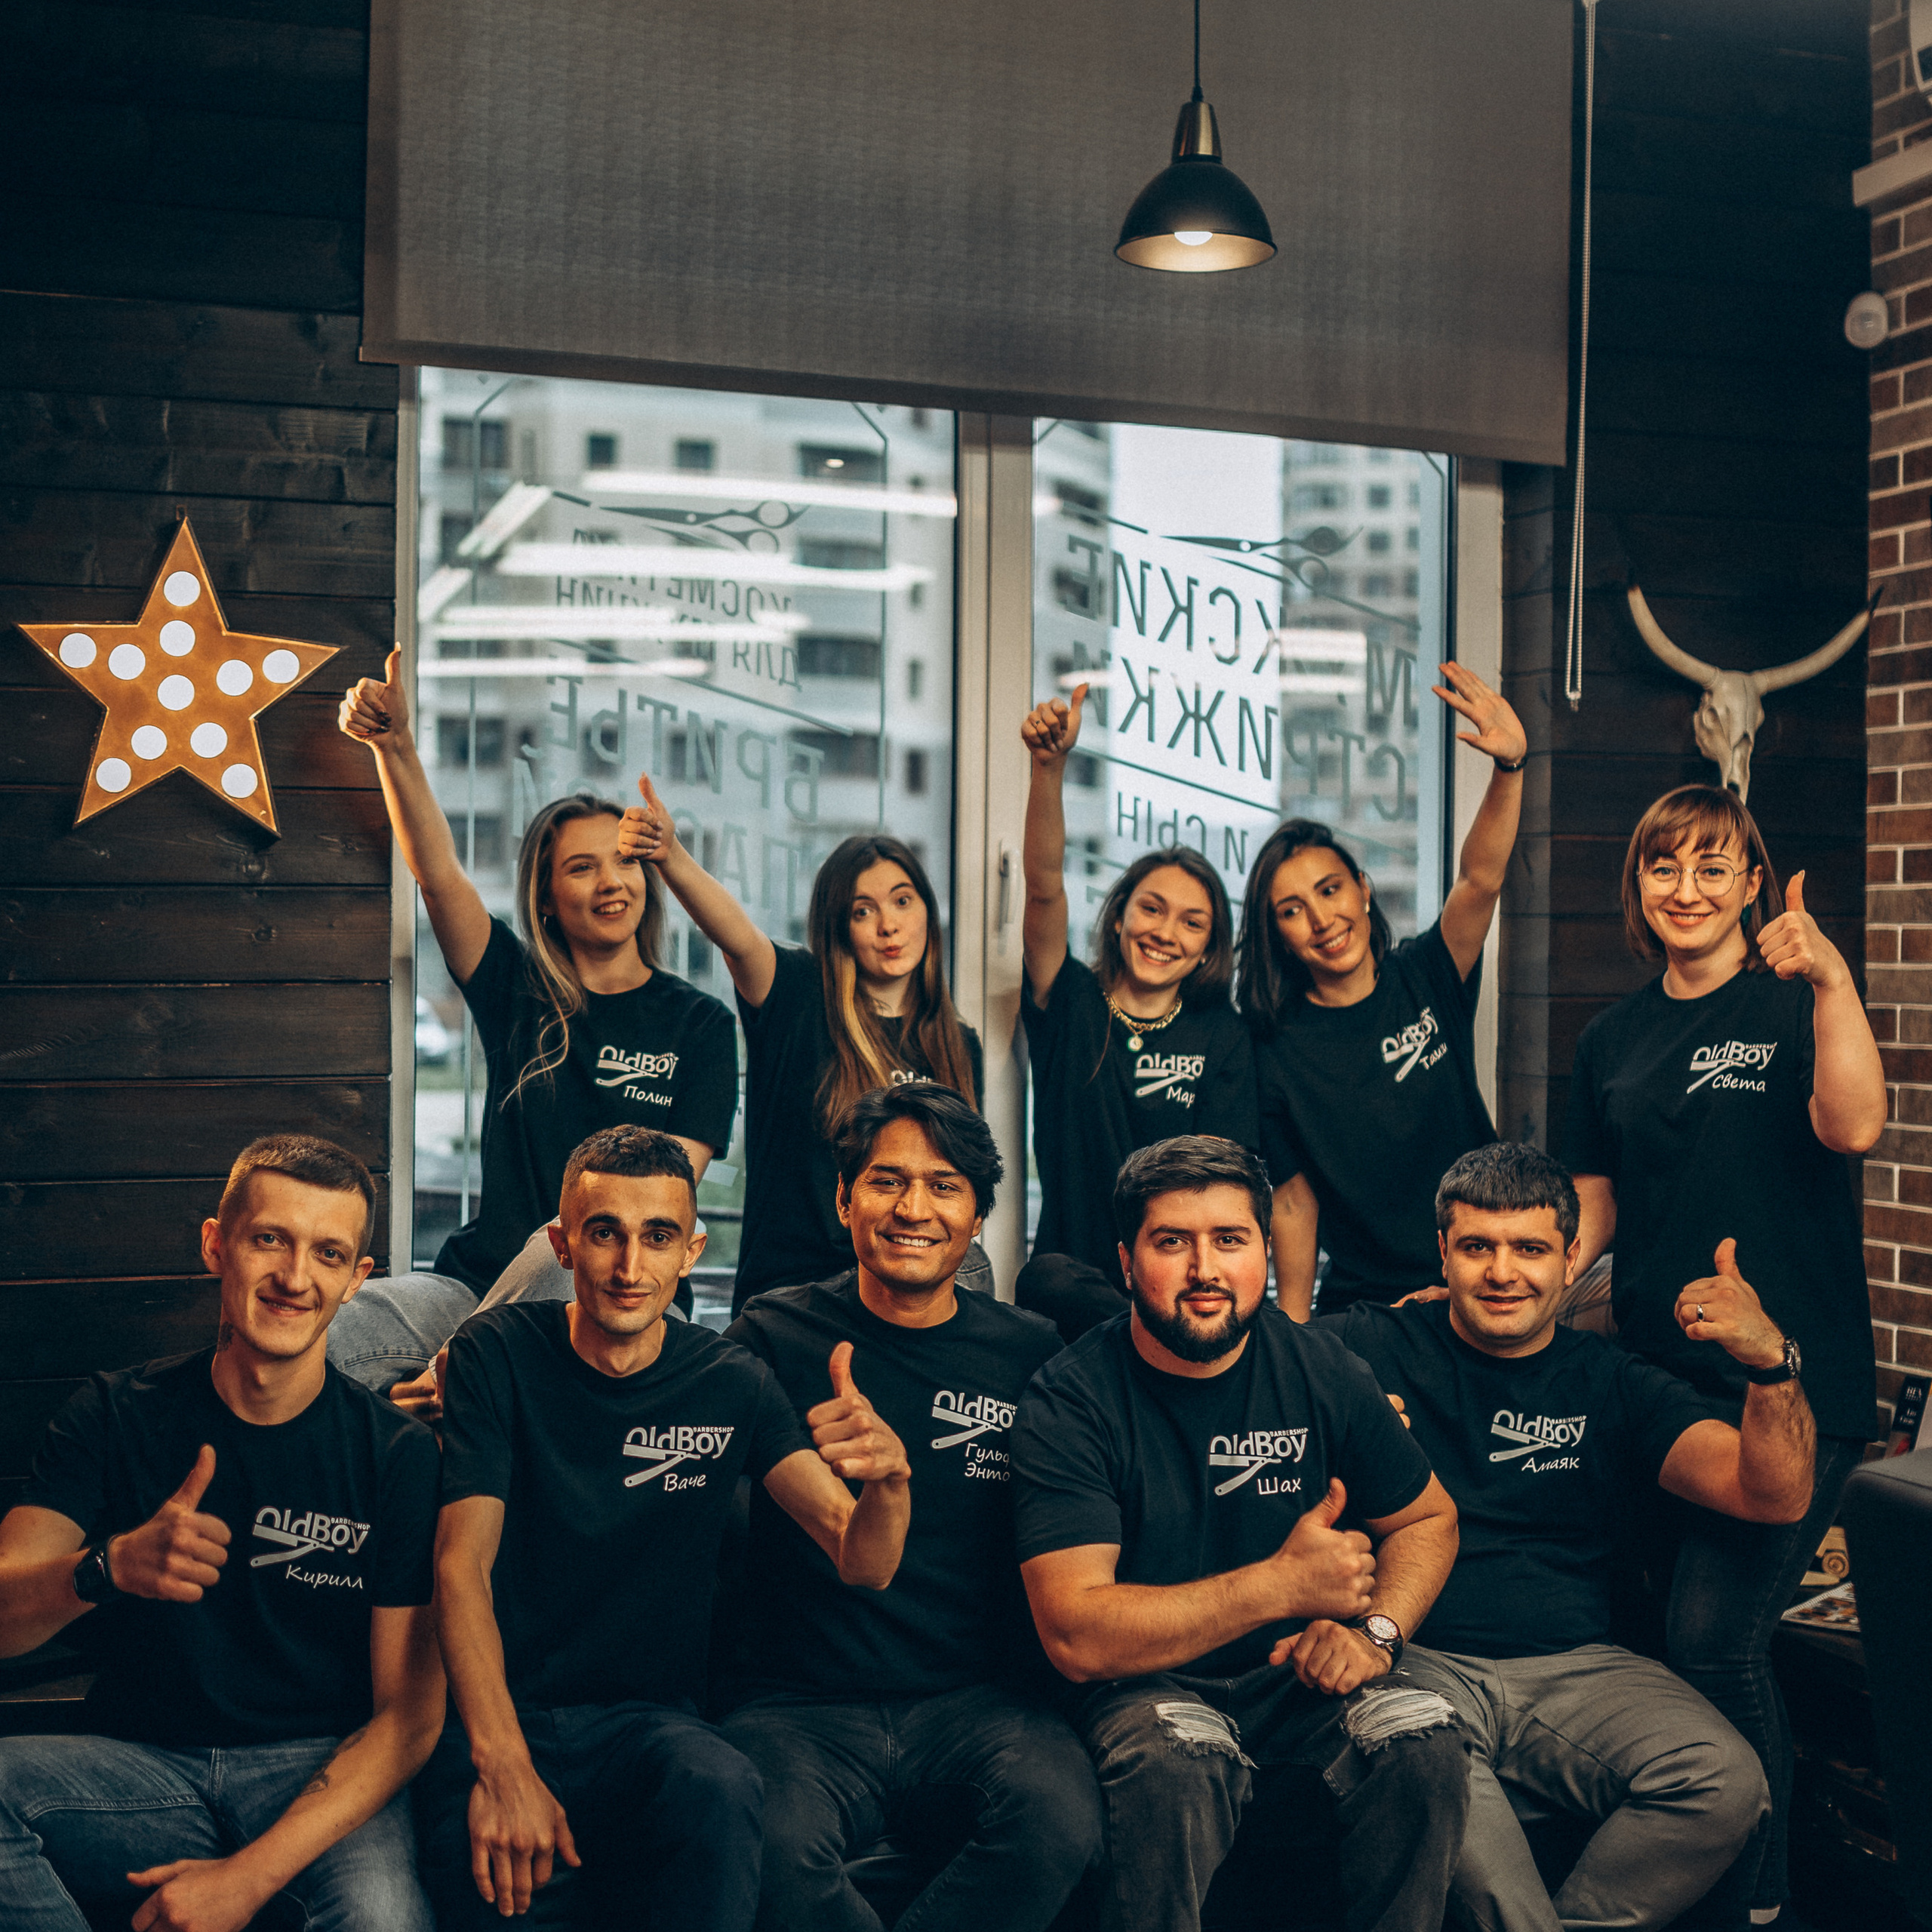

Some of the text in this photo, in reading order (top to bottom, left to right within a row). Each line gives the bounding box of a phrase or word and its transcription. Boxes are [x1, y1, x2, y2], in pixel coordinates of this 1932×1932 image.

[1693, 1040, 1777, 1071] OldBoy
[1712, 1073, 1766, 1093] Света
[623, 1085, 672, 1107] Полин
[934, 1390, 1016, 1429] OldBo
[1269, 1427, 1309, 1438] BARBERSHOP
[1494, 1409, 1586, 1447] OldBoy
[626, 1426, 732, 1459] OldBoy
[1210, 1431, 1307, 1463] OldBoy
[1521, 1457, 1580, 1473] Амаяк
[664, 1473, 706, 1491] Ваче
[1257, 1476, 1302, 1495] Шах
[256, 1507, 368, 1554] OldBoy
[285, 1564, 363, 1589] Кирилл
